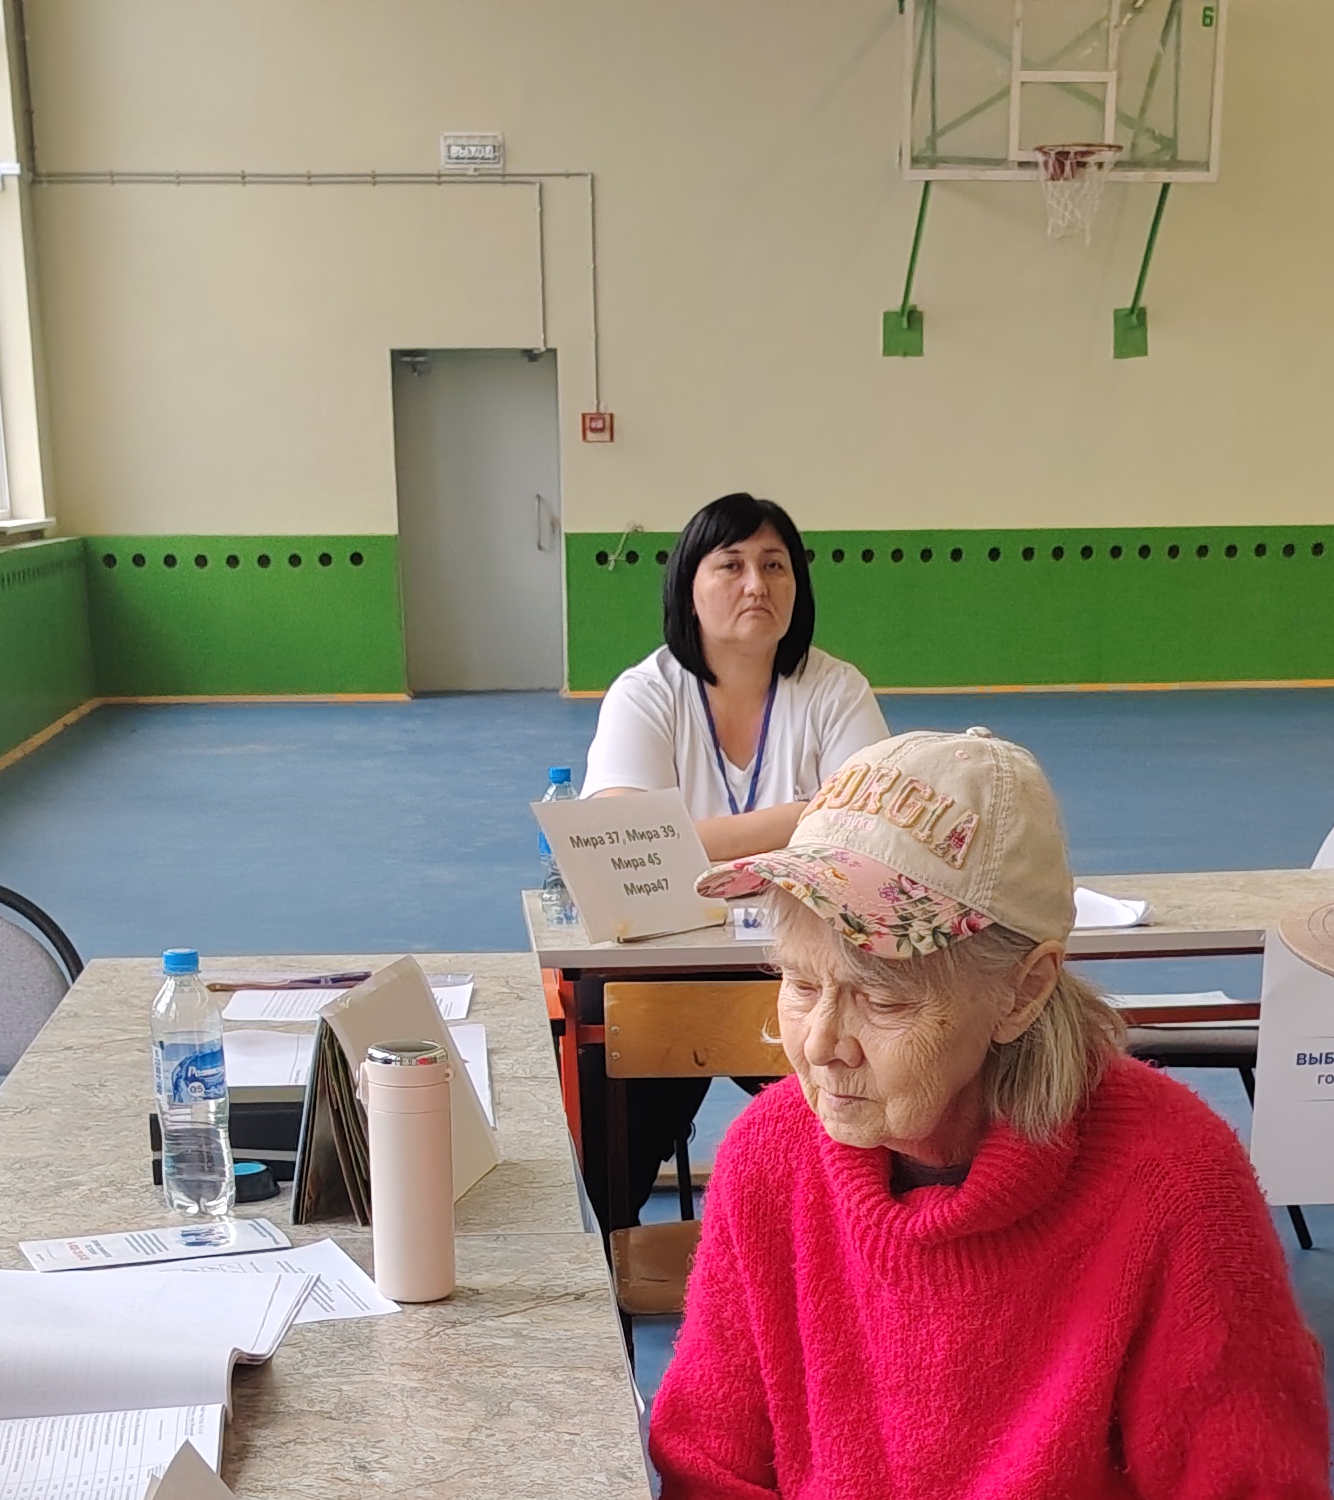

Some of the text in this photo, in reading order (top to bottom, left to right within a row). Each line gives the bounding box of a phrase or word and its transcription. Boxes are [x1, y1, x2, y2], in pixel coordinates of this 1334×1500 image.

[1202, 6, 1214, 27] 6
[569, 834, 605, 849] Мира
[626, 828, 661, 843] Мира
[611, 852, 662, 871] Мира 45
